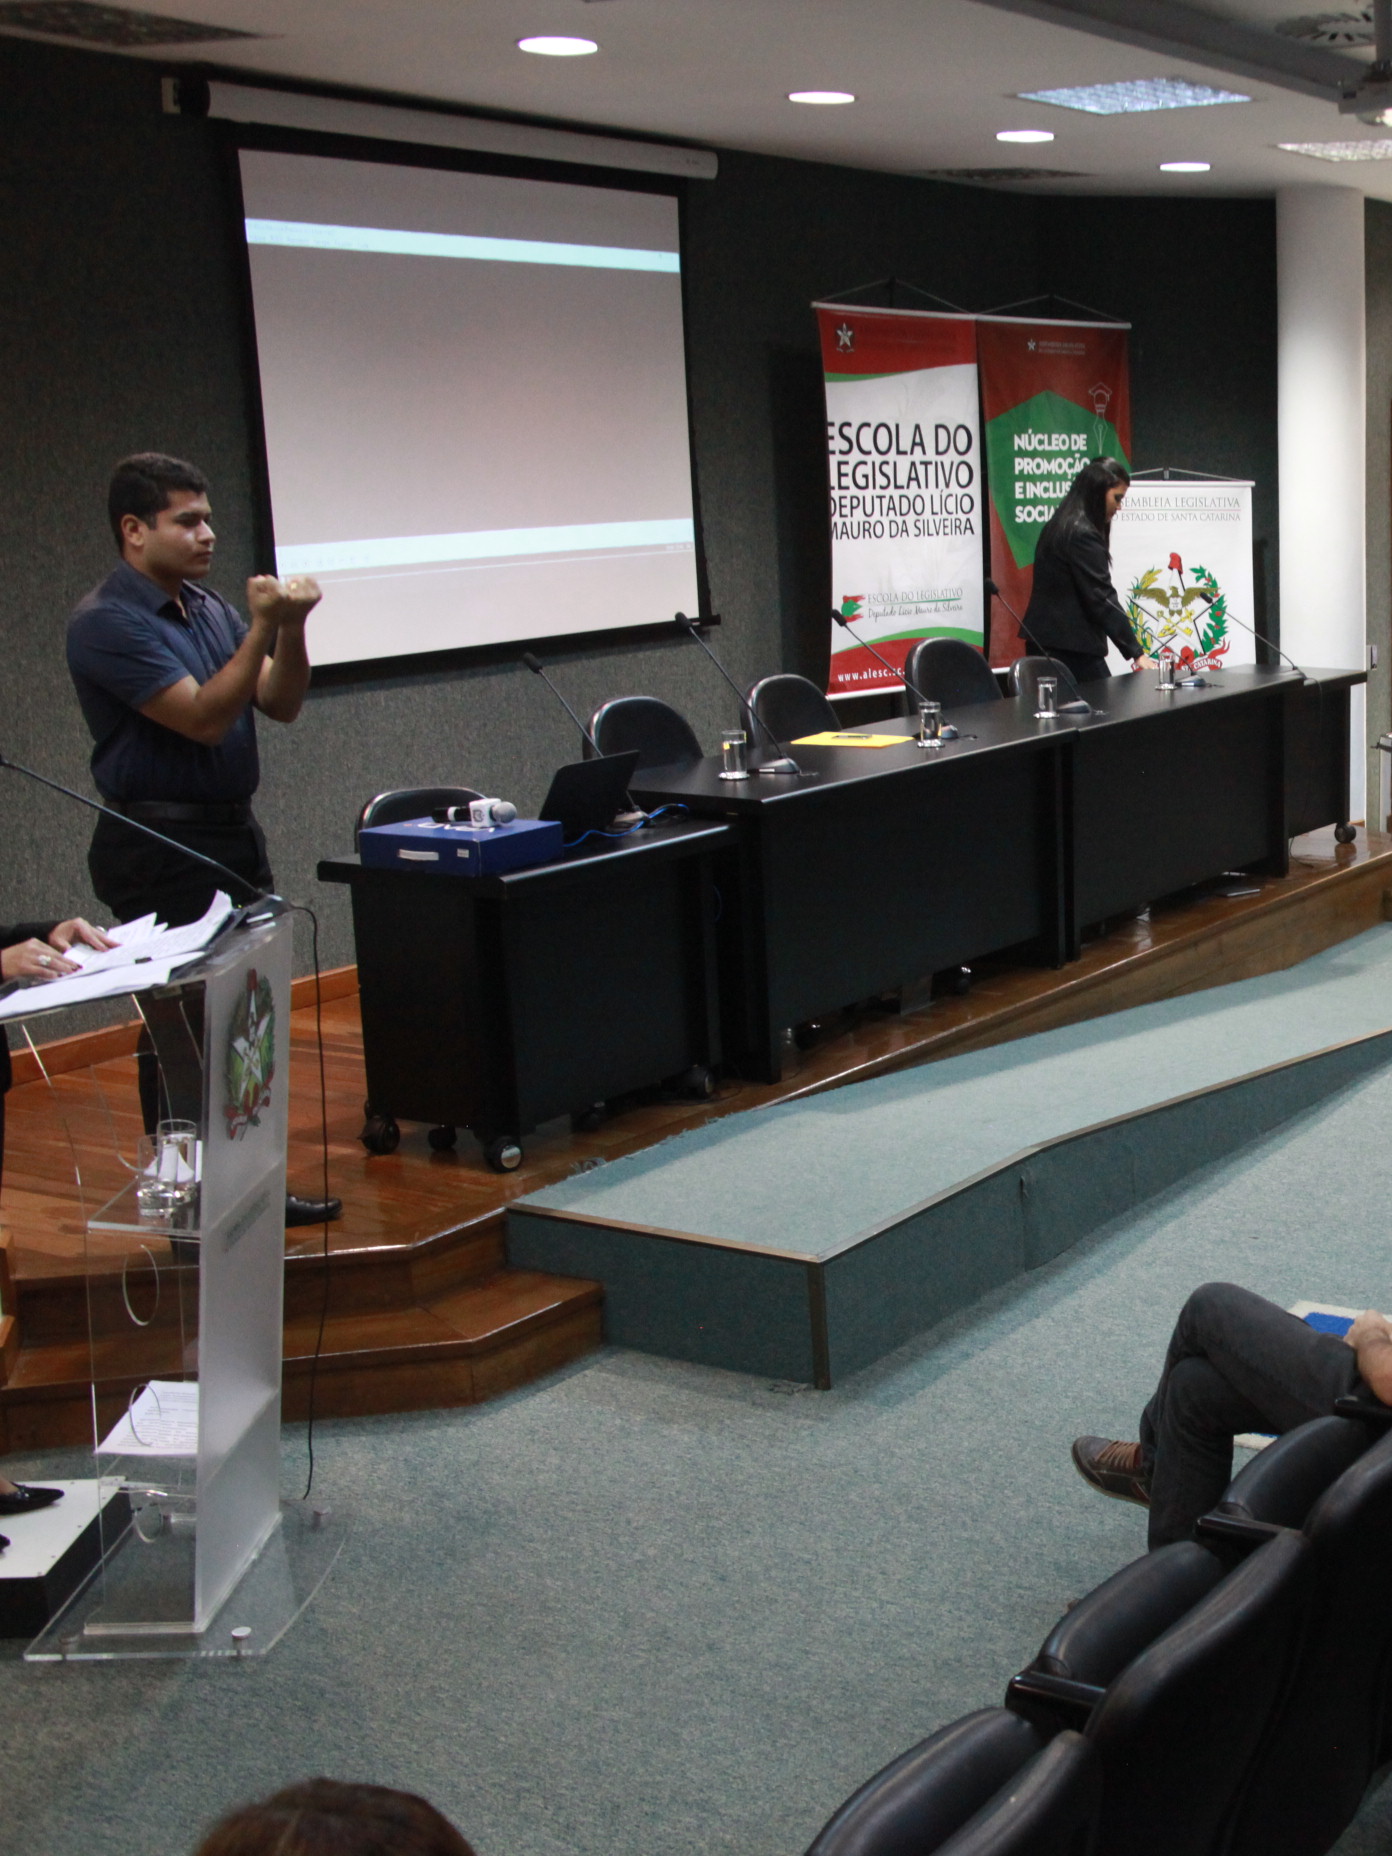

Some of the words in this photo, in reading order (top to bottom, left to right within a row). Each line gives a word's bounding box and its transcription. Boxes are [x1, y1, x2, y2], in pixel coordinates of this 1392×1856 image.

[827, 421, 927, 456] ESCOLA
[934, 423, 973, 456] DO
[1014, 428, 1069, 451] NÚCLEO
[1070, 433, 1088, 451] DE
[1014, 481, 1024, 499] E
[1026, 481, 1073, 499] INCLUS
[930, 489, 975, 516] LÍCIO
[1120, 497, 1170, 508] EMBLEIA
[1174, 496, 1241, 508] LEGISLATIVA
[1014, 505, 1056, 523] SOCIA
[1121, 512, 1156, 521] ESTADO
[1157, 512, 1169, 521] DE
[1171, 512, 1198, 521] SANTA
[1199, 512, 1241, 521] CATARINA
[889, 519, 910, 539] DA
[913, 517, 975, 537] SILVEIRA
[867, 592, 899, 604] ESCOLA
[901, 591, 915, 602] DO
[916, 588, 963, 600] LEGISLATIVO
